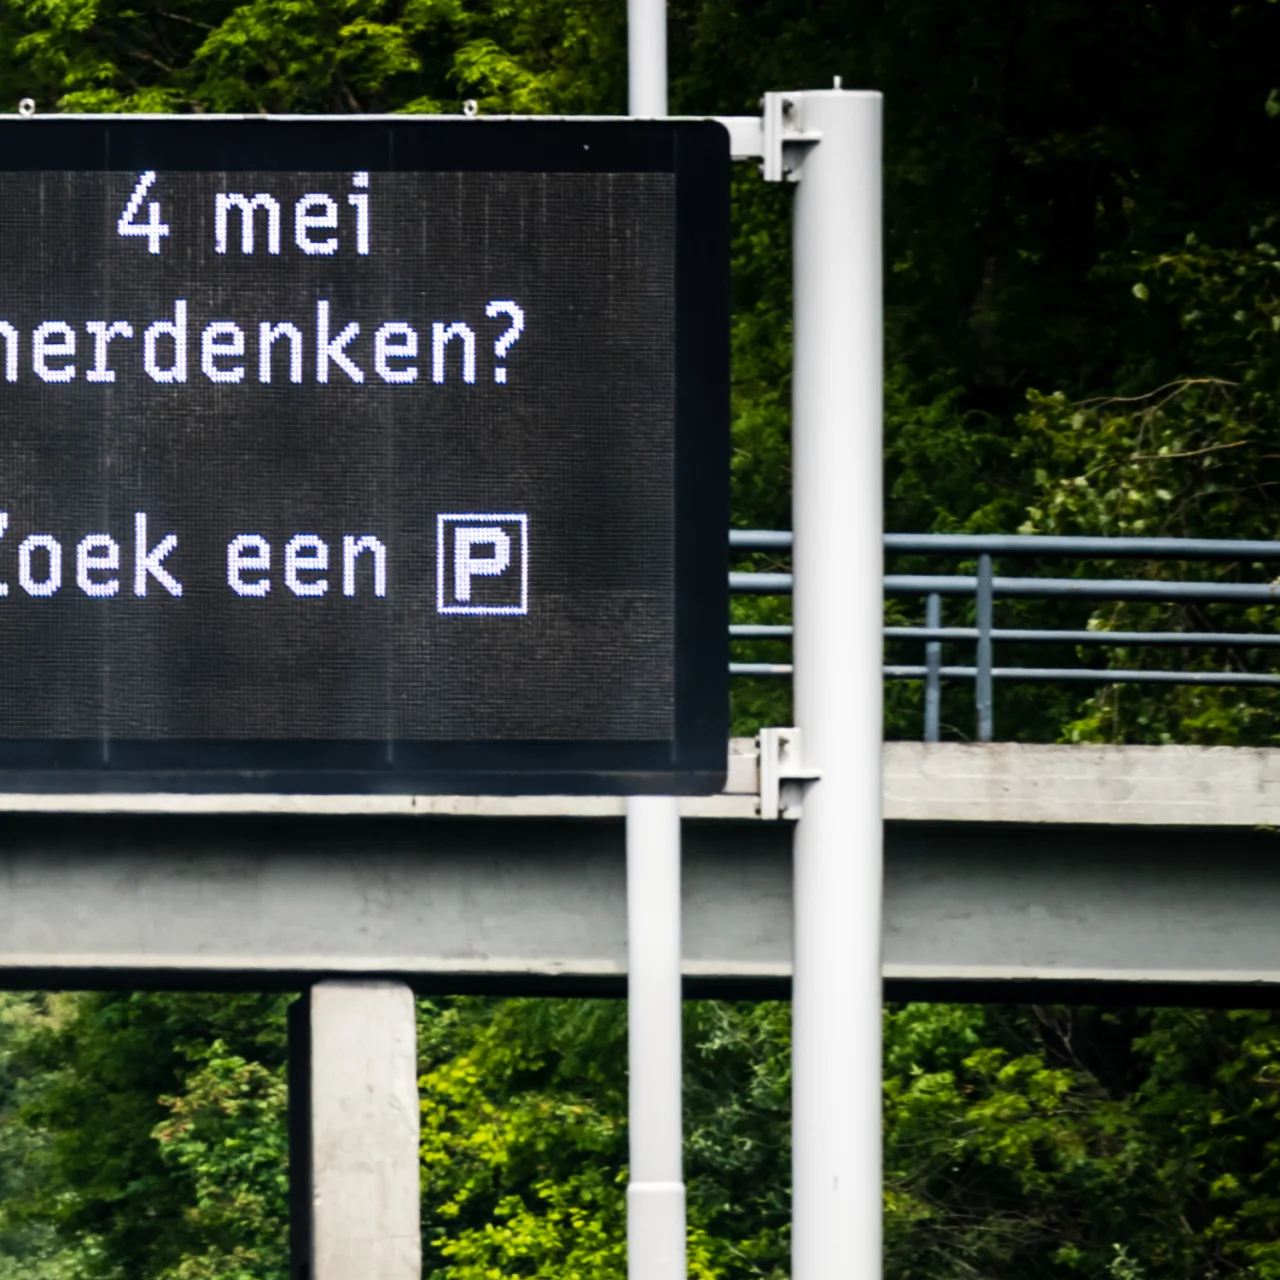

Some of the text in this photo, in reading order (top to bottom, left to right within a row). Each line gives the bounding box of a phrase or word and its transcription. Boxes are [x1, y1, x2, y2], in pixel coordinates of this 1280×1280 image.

[117, 171, 370, 255] 4 mei
[227, 533, 388, 597] een
[452, 525, 512, 602] P
